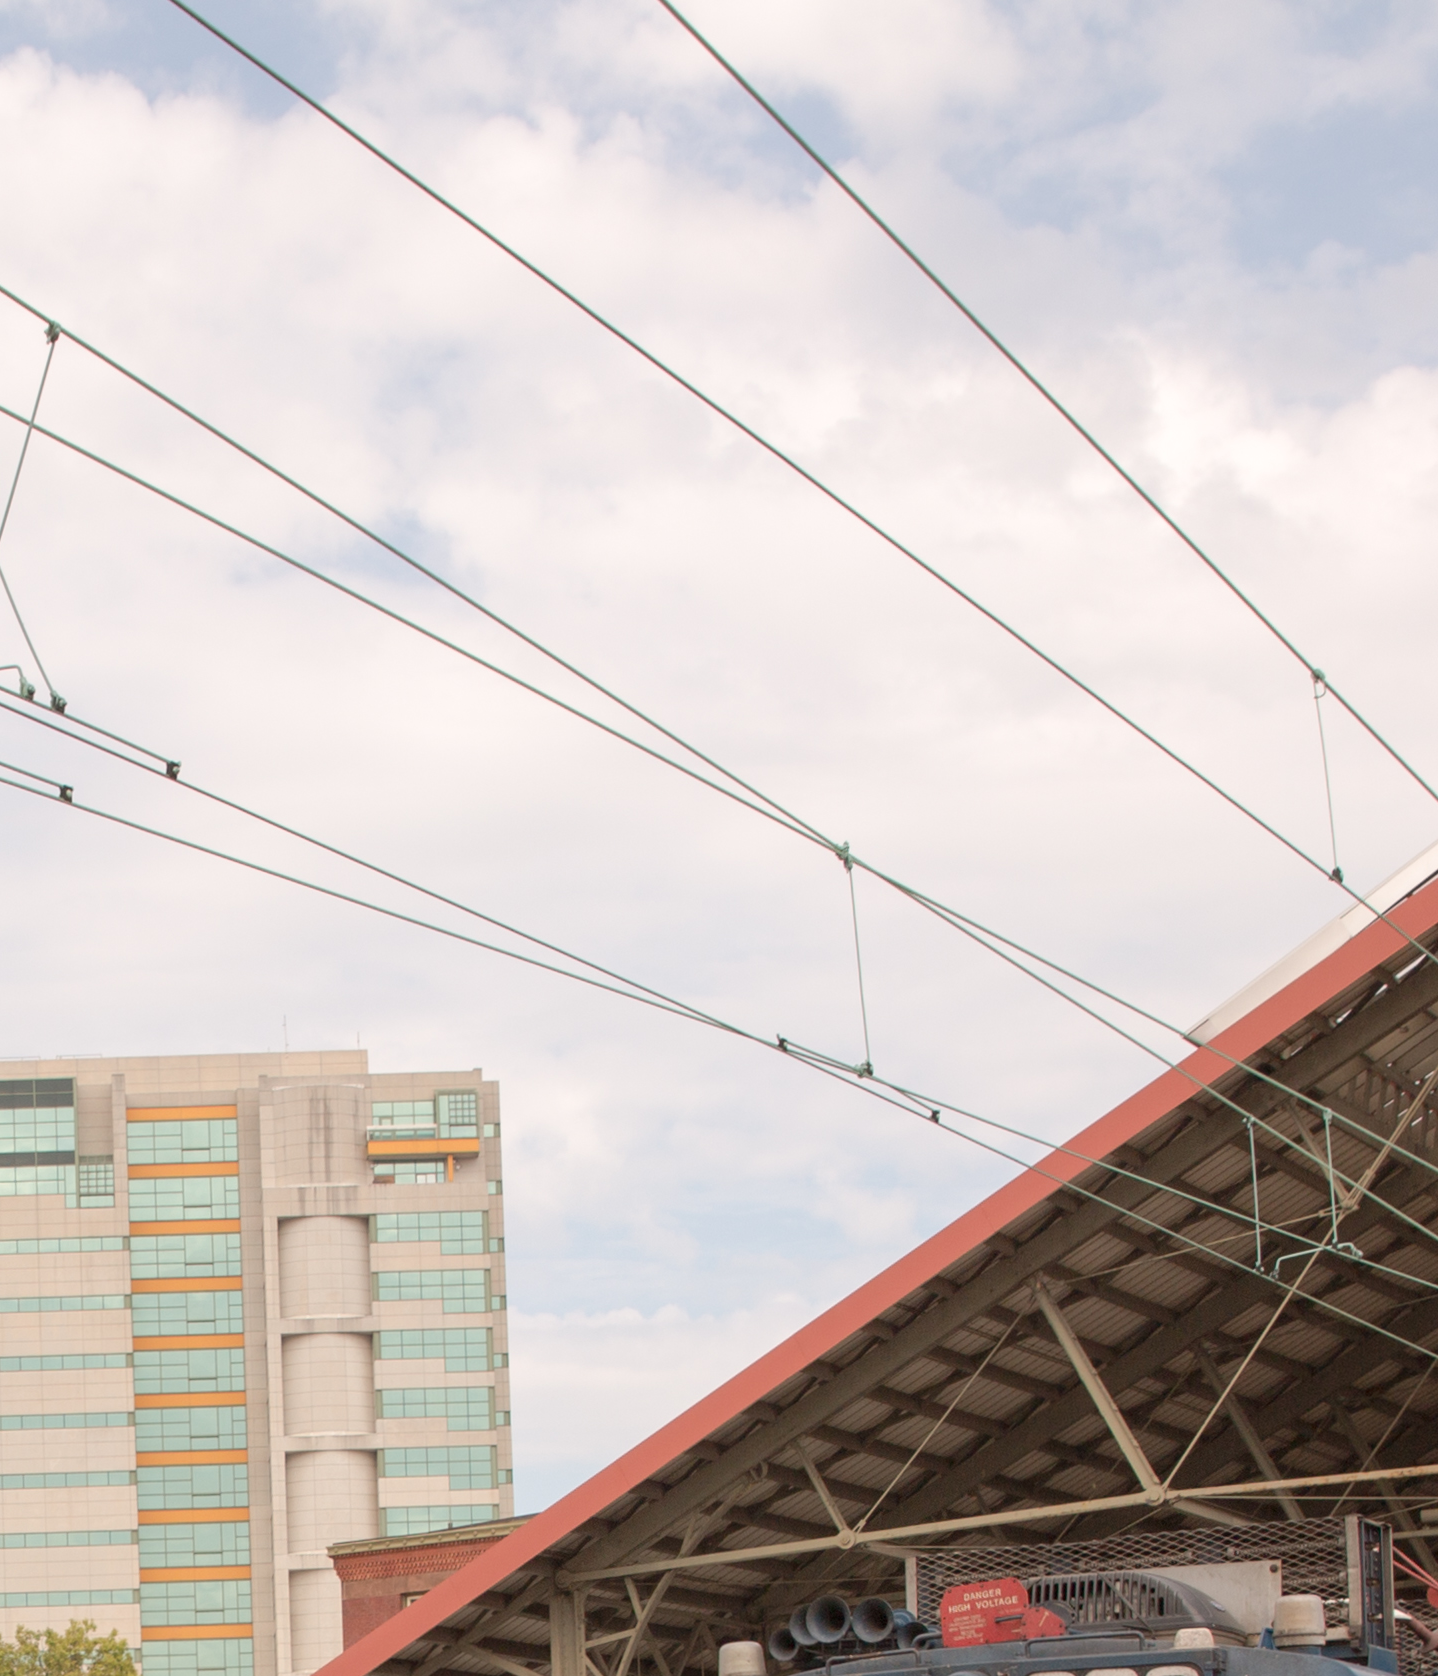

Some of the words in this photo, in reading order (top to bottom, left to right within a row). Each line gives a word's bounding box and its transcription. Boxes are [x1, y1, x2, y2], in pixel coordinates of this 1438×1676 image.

[963, 1588, 1002, 1601] DANGER
[948, 1604, 971, 1614] HIGH
[975, 1596, 1019, 1610] VOLTAGE
